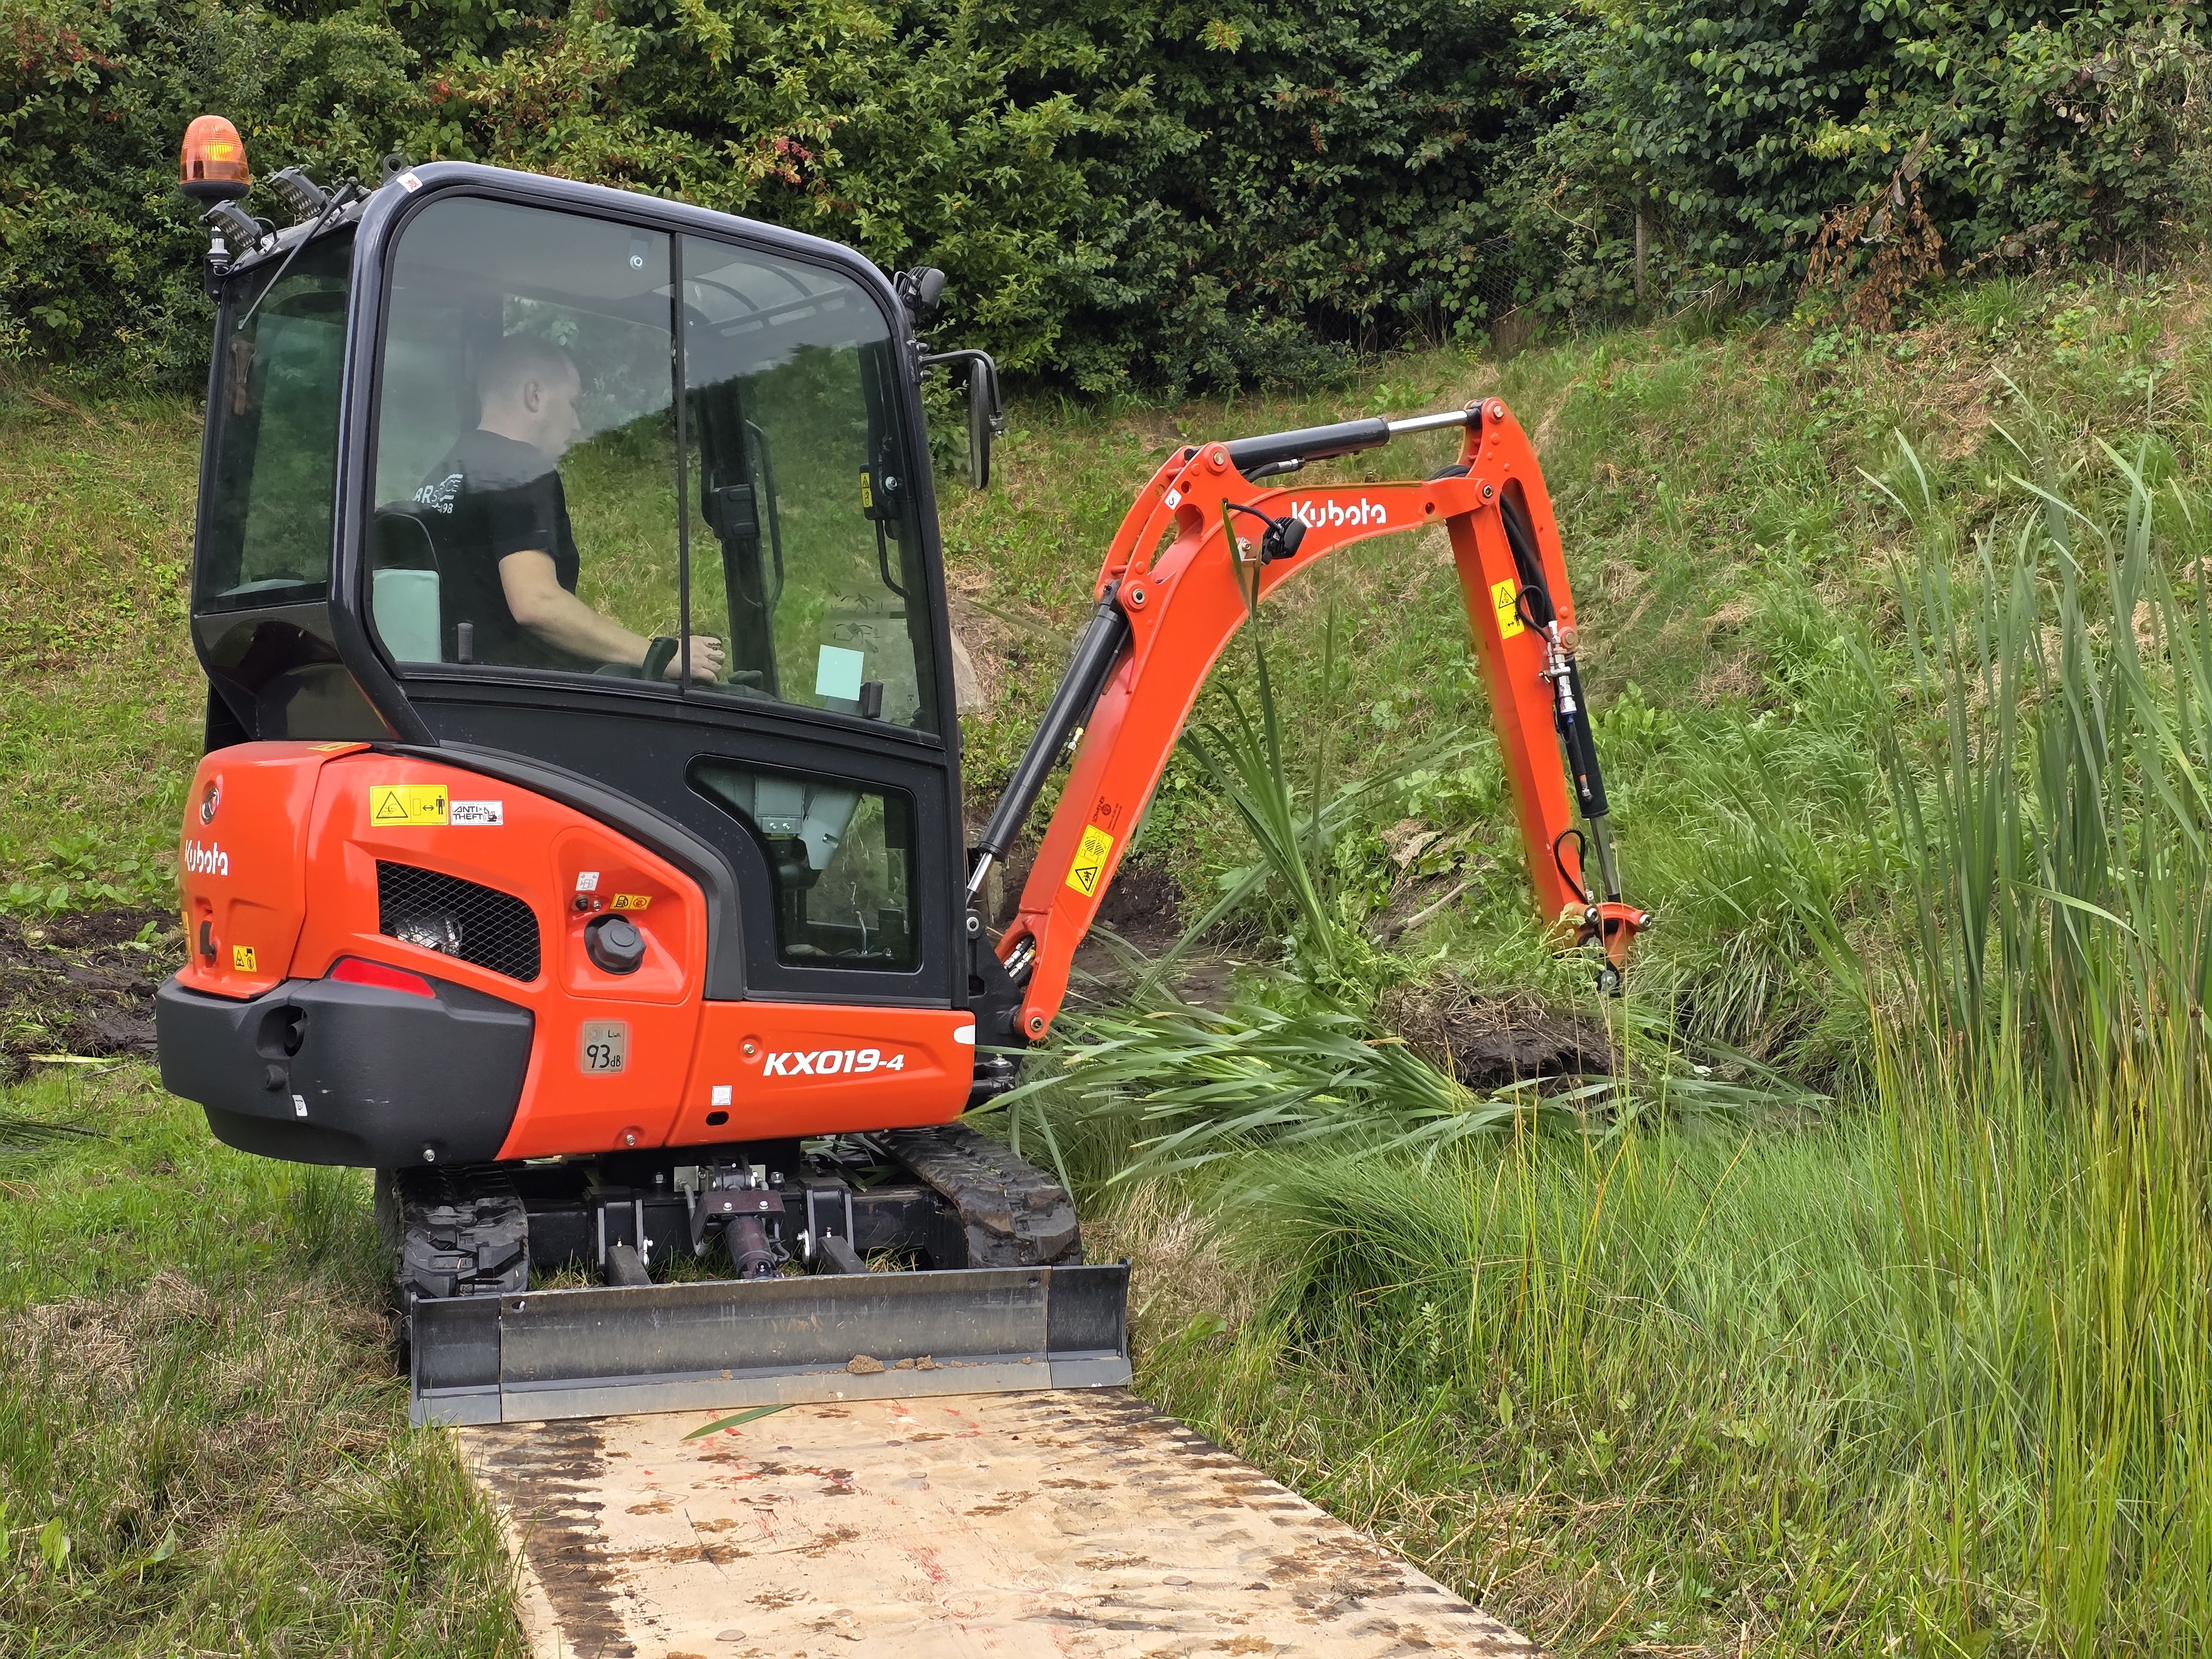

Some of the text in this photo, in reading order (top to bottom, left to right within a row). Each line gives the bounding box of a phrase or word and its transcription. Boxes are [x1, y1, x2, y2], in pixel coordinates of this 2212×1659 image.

[1291, 498, 1386, 528] Kubota
[184, 839, 228, 876] Kubota
[587, 1045, 621, 1068] 93 dB
